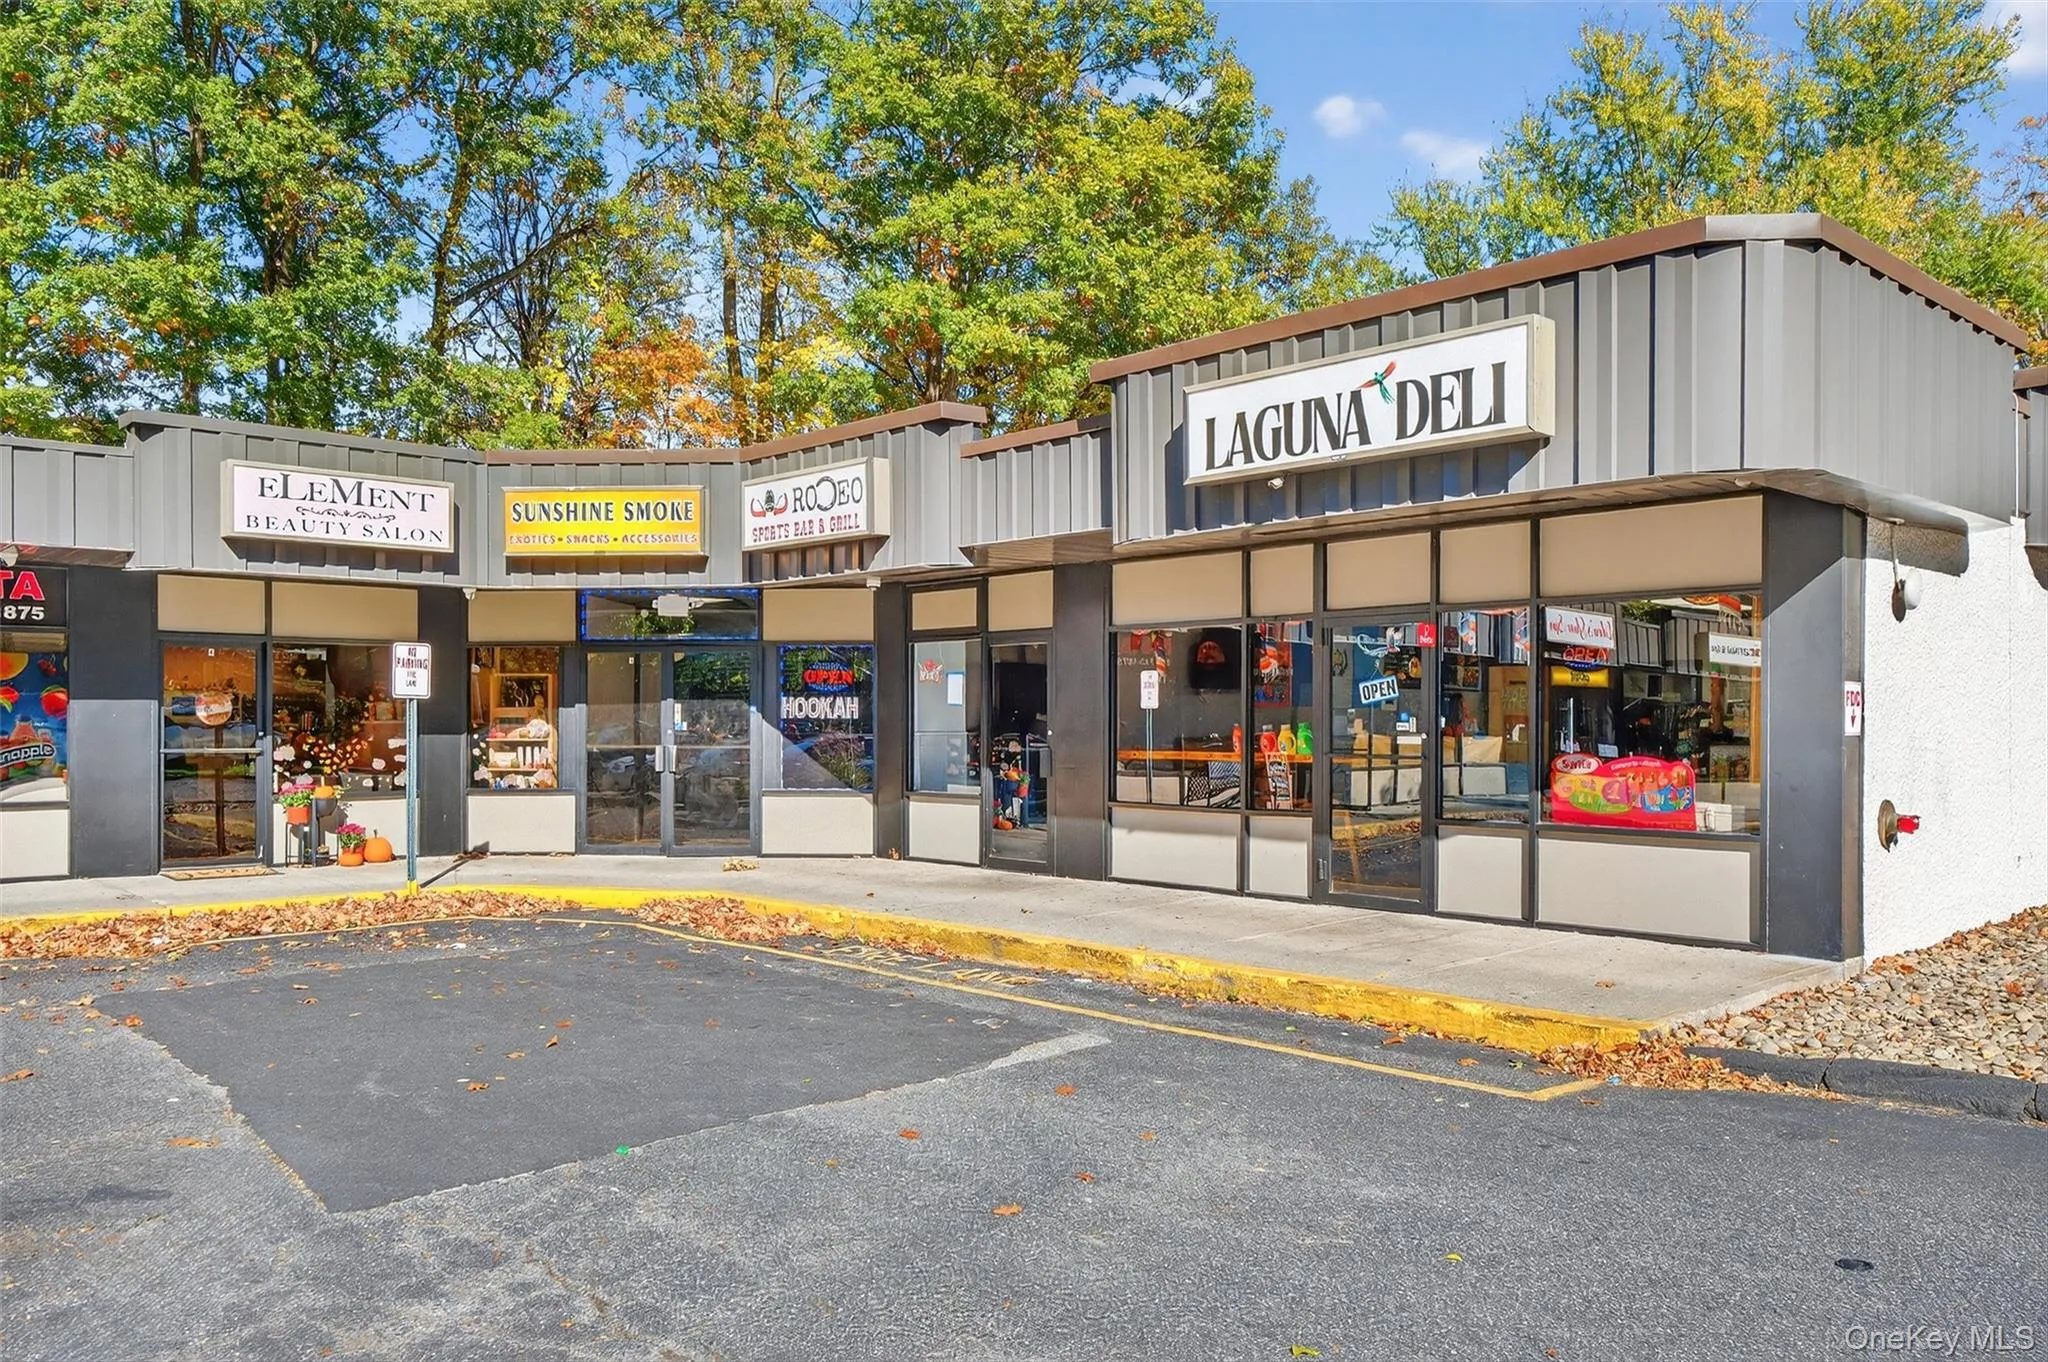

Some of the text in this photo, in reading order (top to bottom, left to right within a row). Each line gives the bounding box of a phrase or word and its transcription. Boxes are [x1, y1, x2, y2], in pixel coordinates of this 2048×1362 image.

[1205, 361, 1507, 472] LAGUNA DELI
[512, 501, 694, 522] SUNSHINE SMOKE
[246, 514, 443, 543] BEAUTY SALON
[752, 512, 861, 543] SPORTS BAR & GRILL
[509, 533, 697, 545] EXOTICS SNACKS ACCESSORIES
[0, 605, 45, 620] 875
[803, 669, 854, 684] OPEN
[1362, 680, 1397, 701] OPEN
[780, 696, 859, 719] HOOKAH
